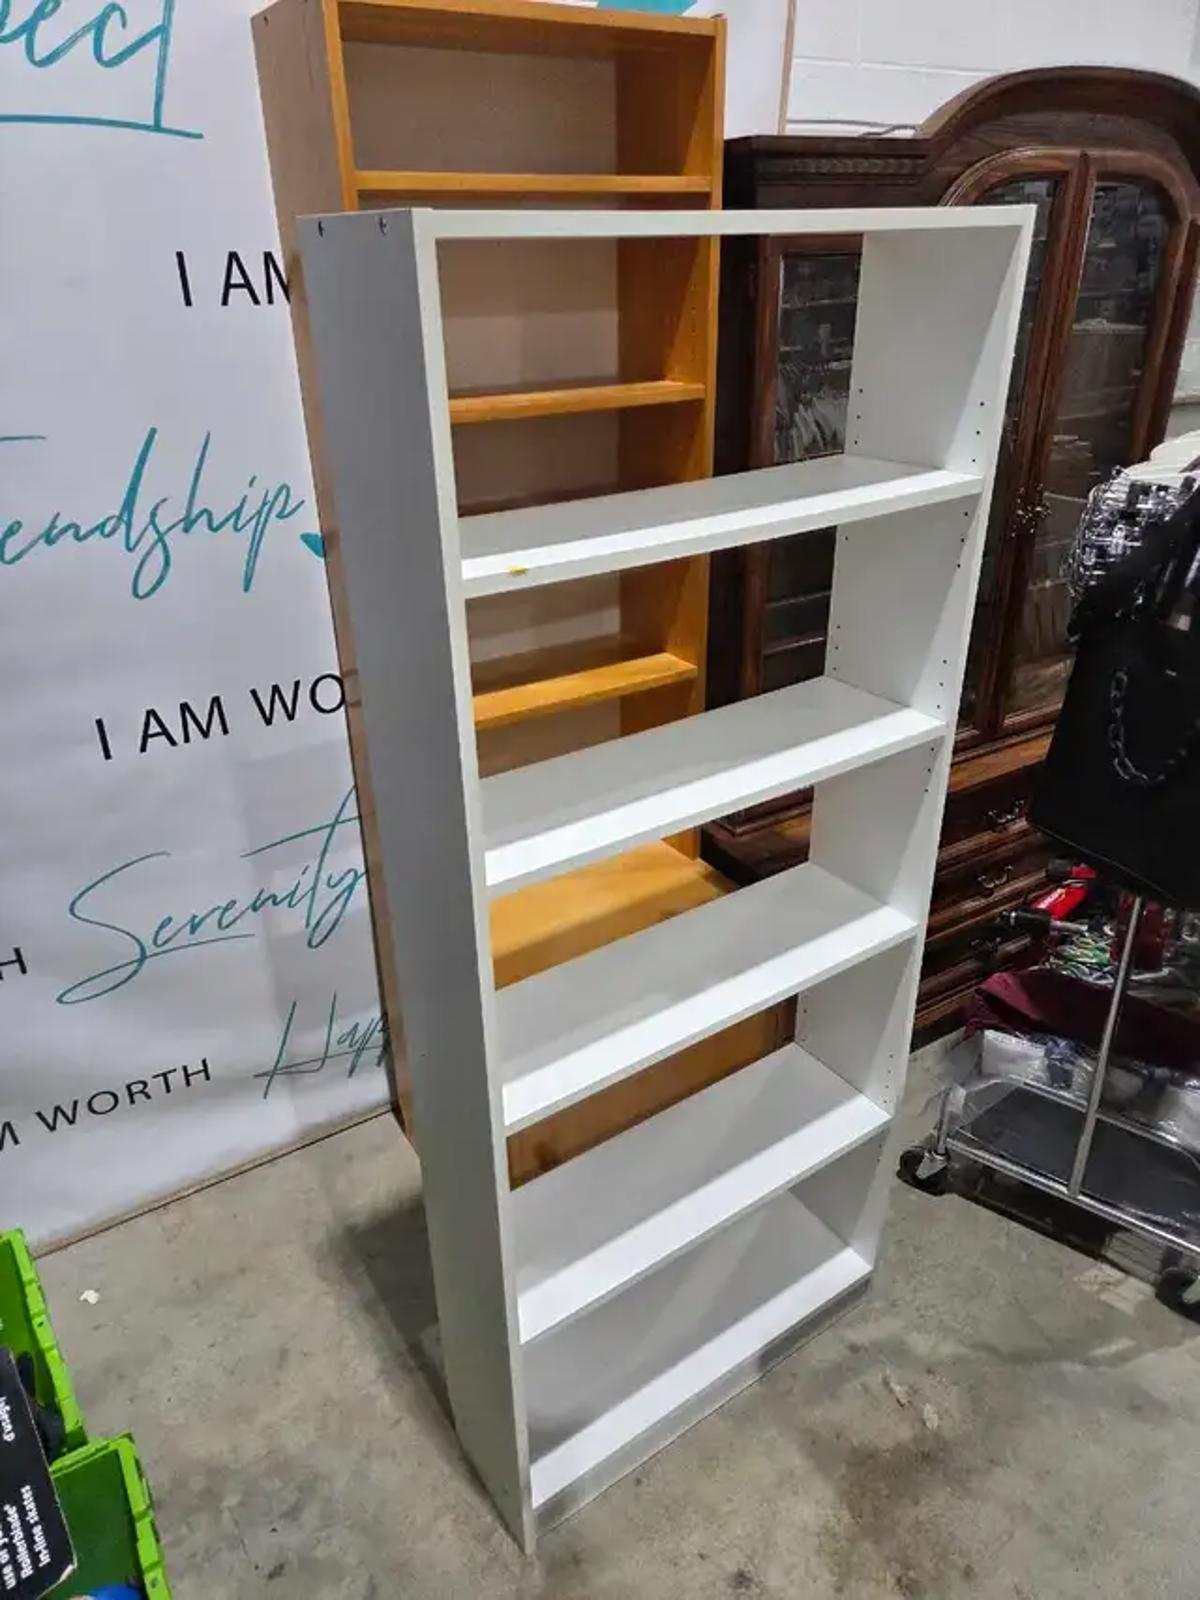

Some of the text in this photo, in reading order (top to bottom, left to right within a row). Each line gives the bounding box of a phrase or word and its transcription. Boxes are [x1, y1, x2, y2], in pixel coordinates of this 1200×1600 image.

[176, 250, 192, 307] I
[95, 717, 113, 761] I
[139, 694, 230, 754] AM
[56, 785, 367, 1004] Serenity
[36, 1057, 211, 1133] WORTH
[20, 1485, 39, 1524] skates
